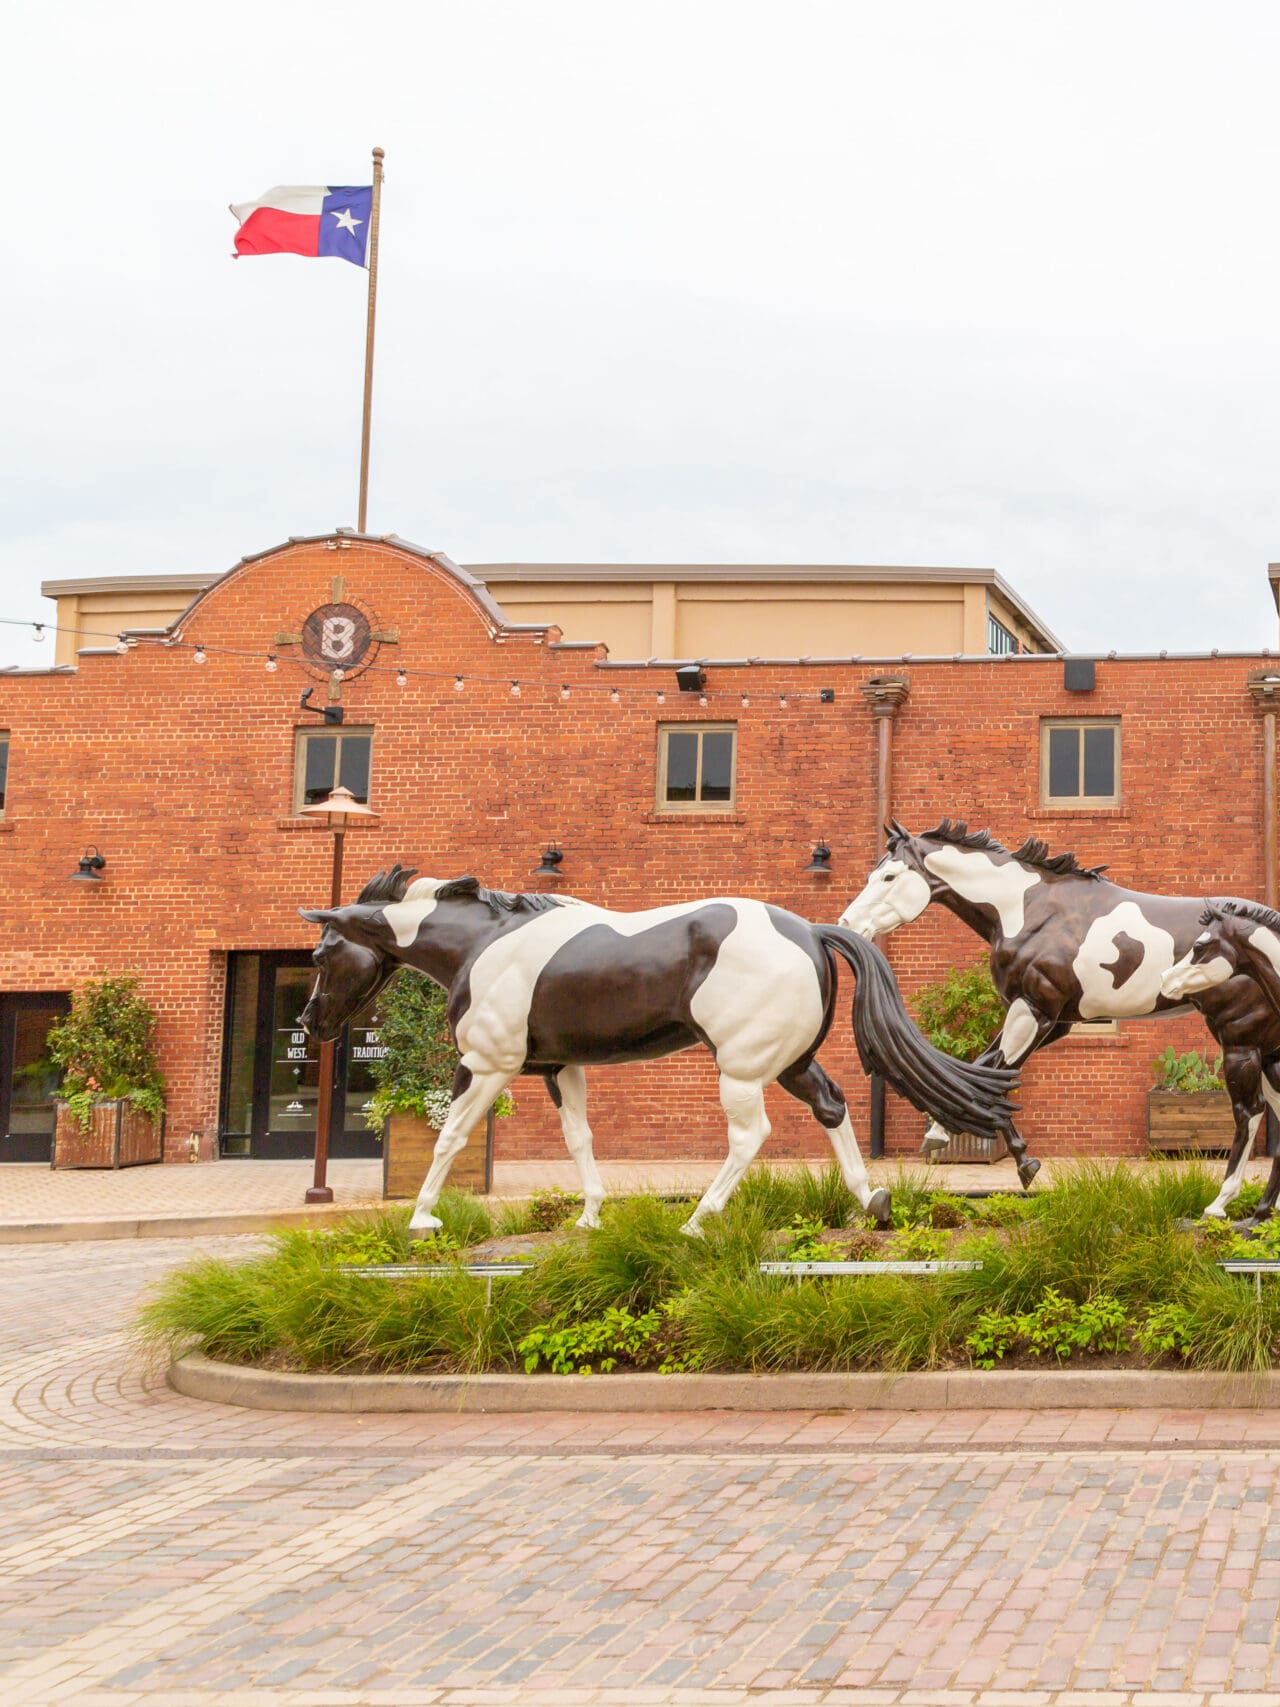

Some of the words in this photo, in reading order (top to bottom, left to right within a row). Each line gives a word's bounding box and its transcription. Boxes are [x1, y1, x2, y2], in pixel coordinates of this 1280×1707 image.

[321, 616, 356, 659] B
[291, 1032, 305, 1044] OLD
[287, 1047, 308, 1059] WEST.
